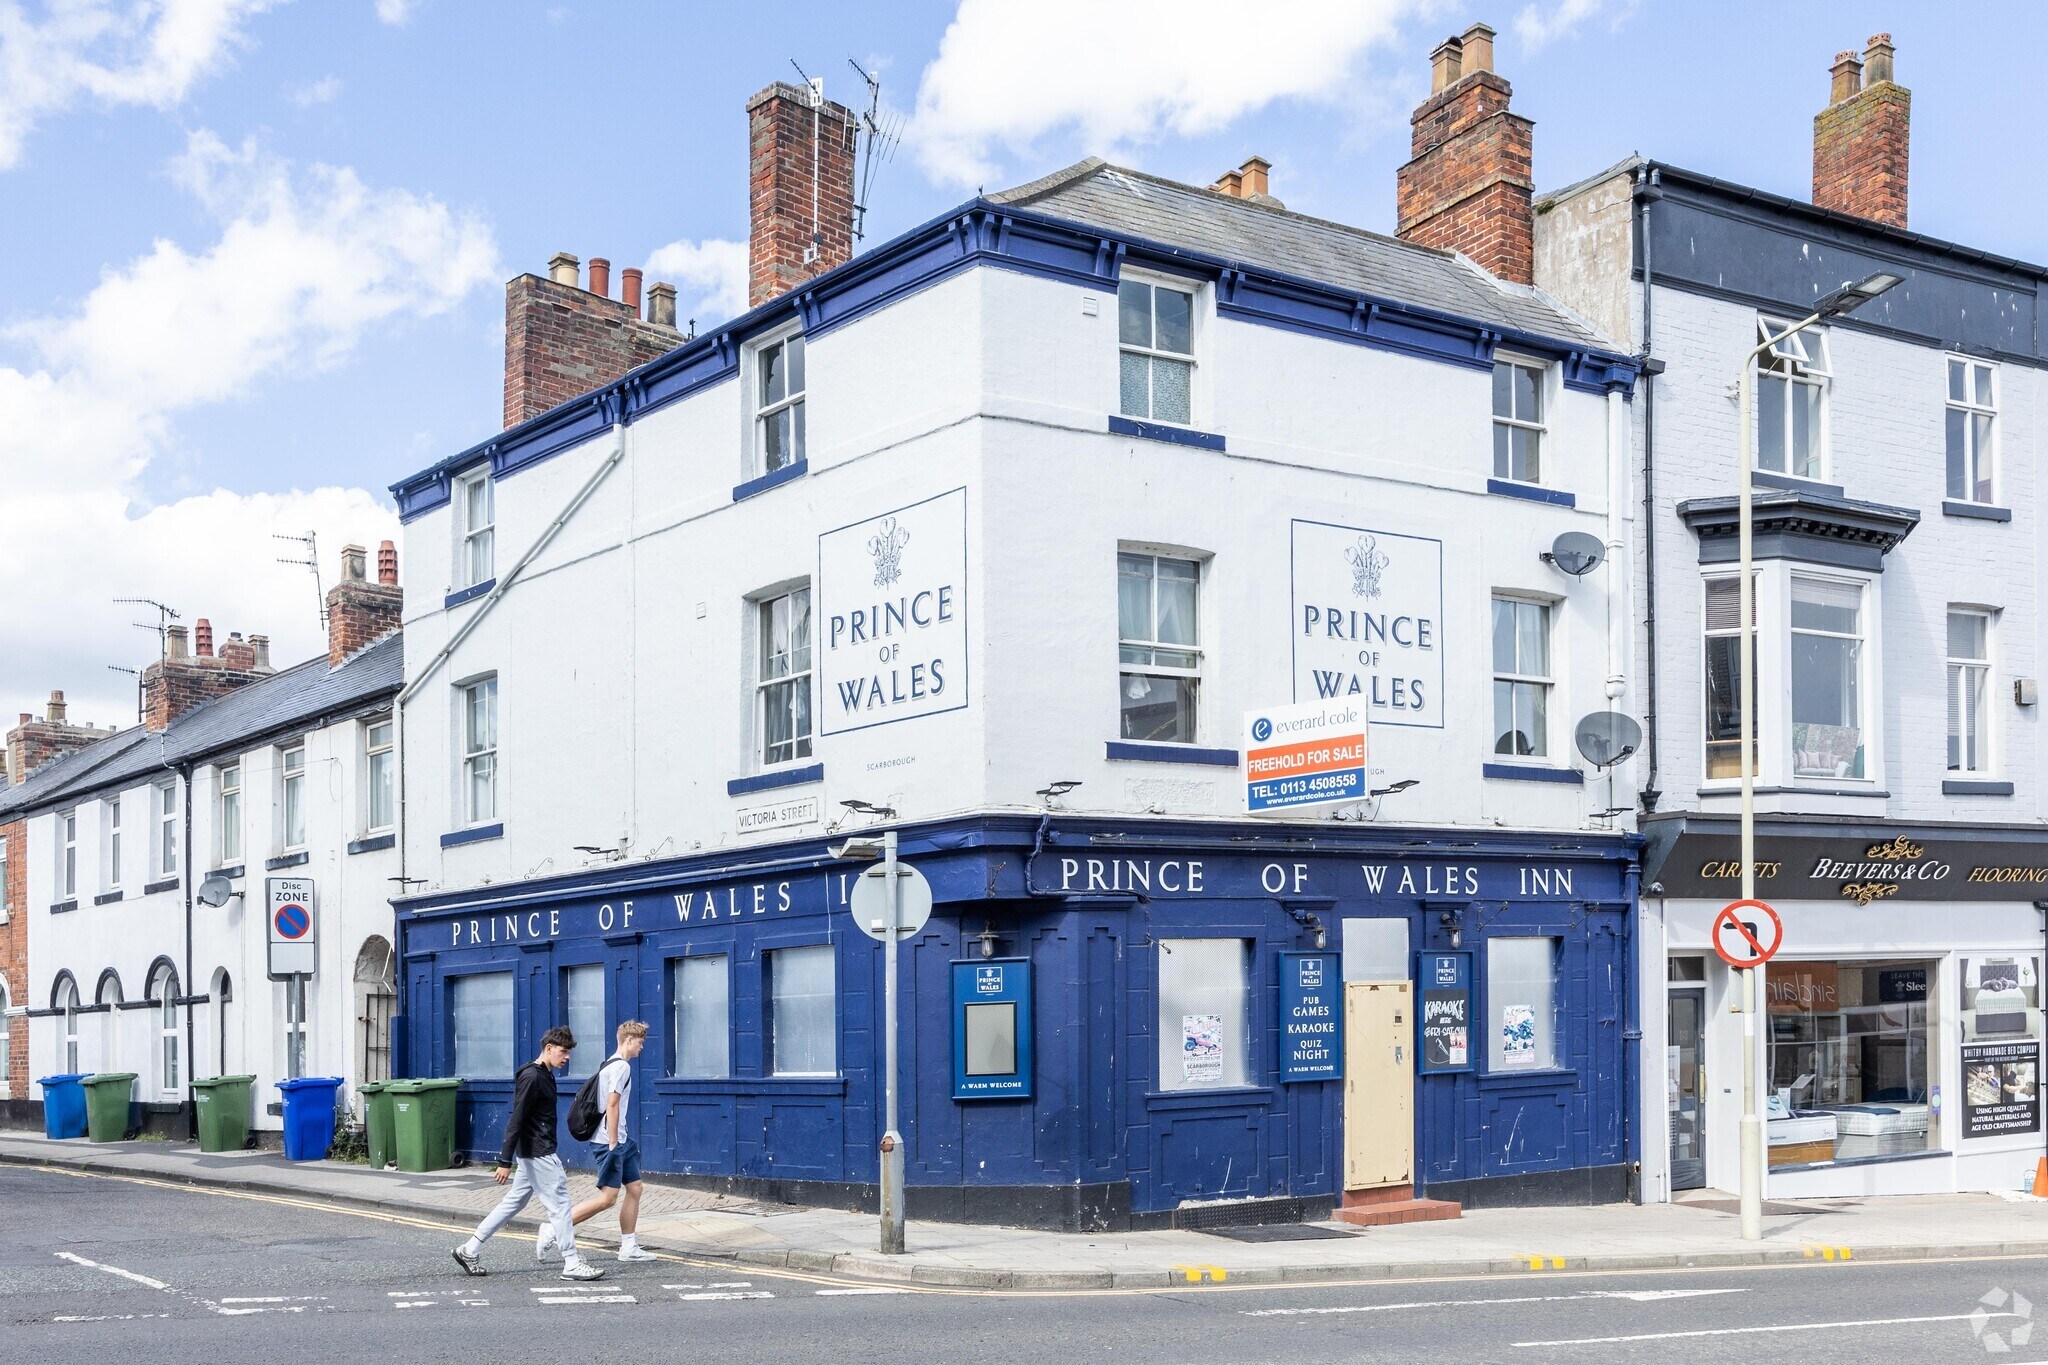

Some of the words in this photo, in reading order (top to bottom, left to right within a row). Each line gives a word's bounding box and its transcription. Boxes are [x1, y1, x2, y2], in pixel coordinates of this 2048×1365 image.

[830, 585, 953, 650] PRINCE
[1303, 604, 1433, 651] PRINCE
[879, 643, 900, 664] OF
[1358, 650, 1380, 667] OF
[837, 658, 945, 715] WALES
[1312, 669, 1424, 711] WALES
[1276, 710, 1326, 734] everard
[1329, 707, 1358, 725] cole
[866, 756, 916, 772] SCARBOROUGH
[1248, 753, 1305, 774] FREEHOLD
[1308, 749, 1331, 764] FOR
[1333, 744, 1363, 762] SALE
[1252, 785, 1278, 799] TEL:
[1281, 780, 1307, 795] 0113
[1309, 773, 1357, 791] 4508558
[1266, 789, 1346, 805] www.everardcole.co.uk
[739, 811, 777, 827] VICTORIA
[781, 803, 813, 820] STREET
[1061, 858, 1204, 893] PRINCE
[1261, 862, 1308, 893] OF
[1362, 865, 1479, 895] WALES
[1520, 868, 1573, 895] INN
[1967, 867, 2047, 884] FLOORING
[281, 882, 302, 890] Disc
[275, 892, 309, 902] ZONE
[451, 909, 561, 946] PRINCE
[599, 901, 634, 931] OF
[674, 881, 791, 923] WALES
[1303, 996, 1320, 1005] PUB
[1293, 1006, 1330, 1017] GAMES
[1424, 999, 1465, 1024] KARAOKE
[1288, 1022, 1335, 1034] KARAOKE
[1300, 1039, 1322, 1050] QUIZ
[1963, 1048, 1982, 1058] WHITBY
[1982, 1046, 2007, 1056] HANDMADE
[2007, 1045, 2016, 1055] BED
[2016, 1044, 2037, 1054] COMPANY
[1293, 1049, 1330, 1061] NIGHT
[990, 1081, 1022, 1089] WELCOME
[1976, 1107, 1992, 1115] USING
[2007, 1104, 2027, 1112] QUALITY
[1971, 1115, 1994, 1123] NATURAL
[1994, 1113, 2020, 1121] MATERIALS
[1993, 1120, 2032, 1130] CRAFTSMANSHIP
